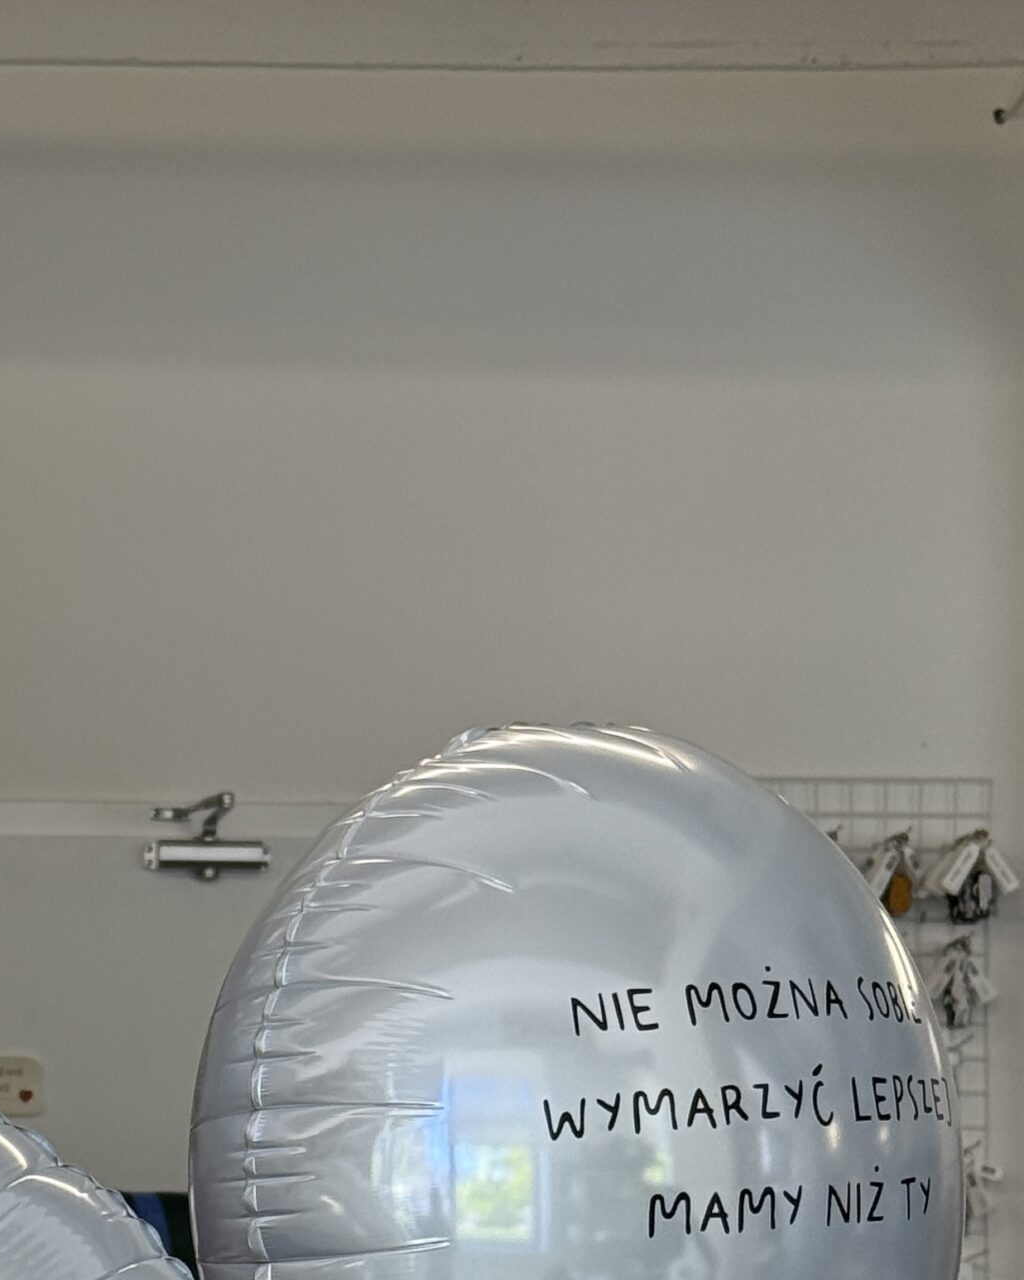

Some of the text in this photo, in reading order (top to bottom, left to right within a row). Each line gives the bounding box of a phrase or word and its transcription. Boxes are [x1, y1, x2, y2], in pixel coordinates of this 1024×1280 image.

[571, 988, 659, 1036] NIE
[685, 965, 849, 1026] MOŻNA
[543, 1063, 952, 1141] WYMARZYĆ LEPSZEJ
[648, 1165, 932, 1239] MAMY NIŻ TY
